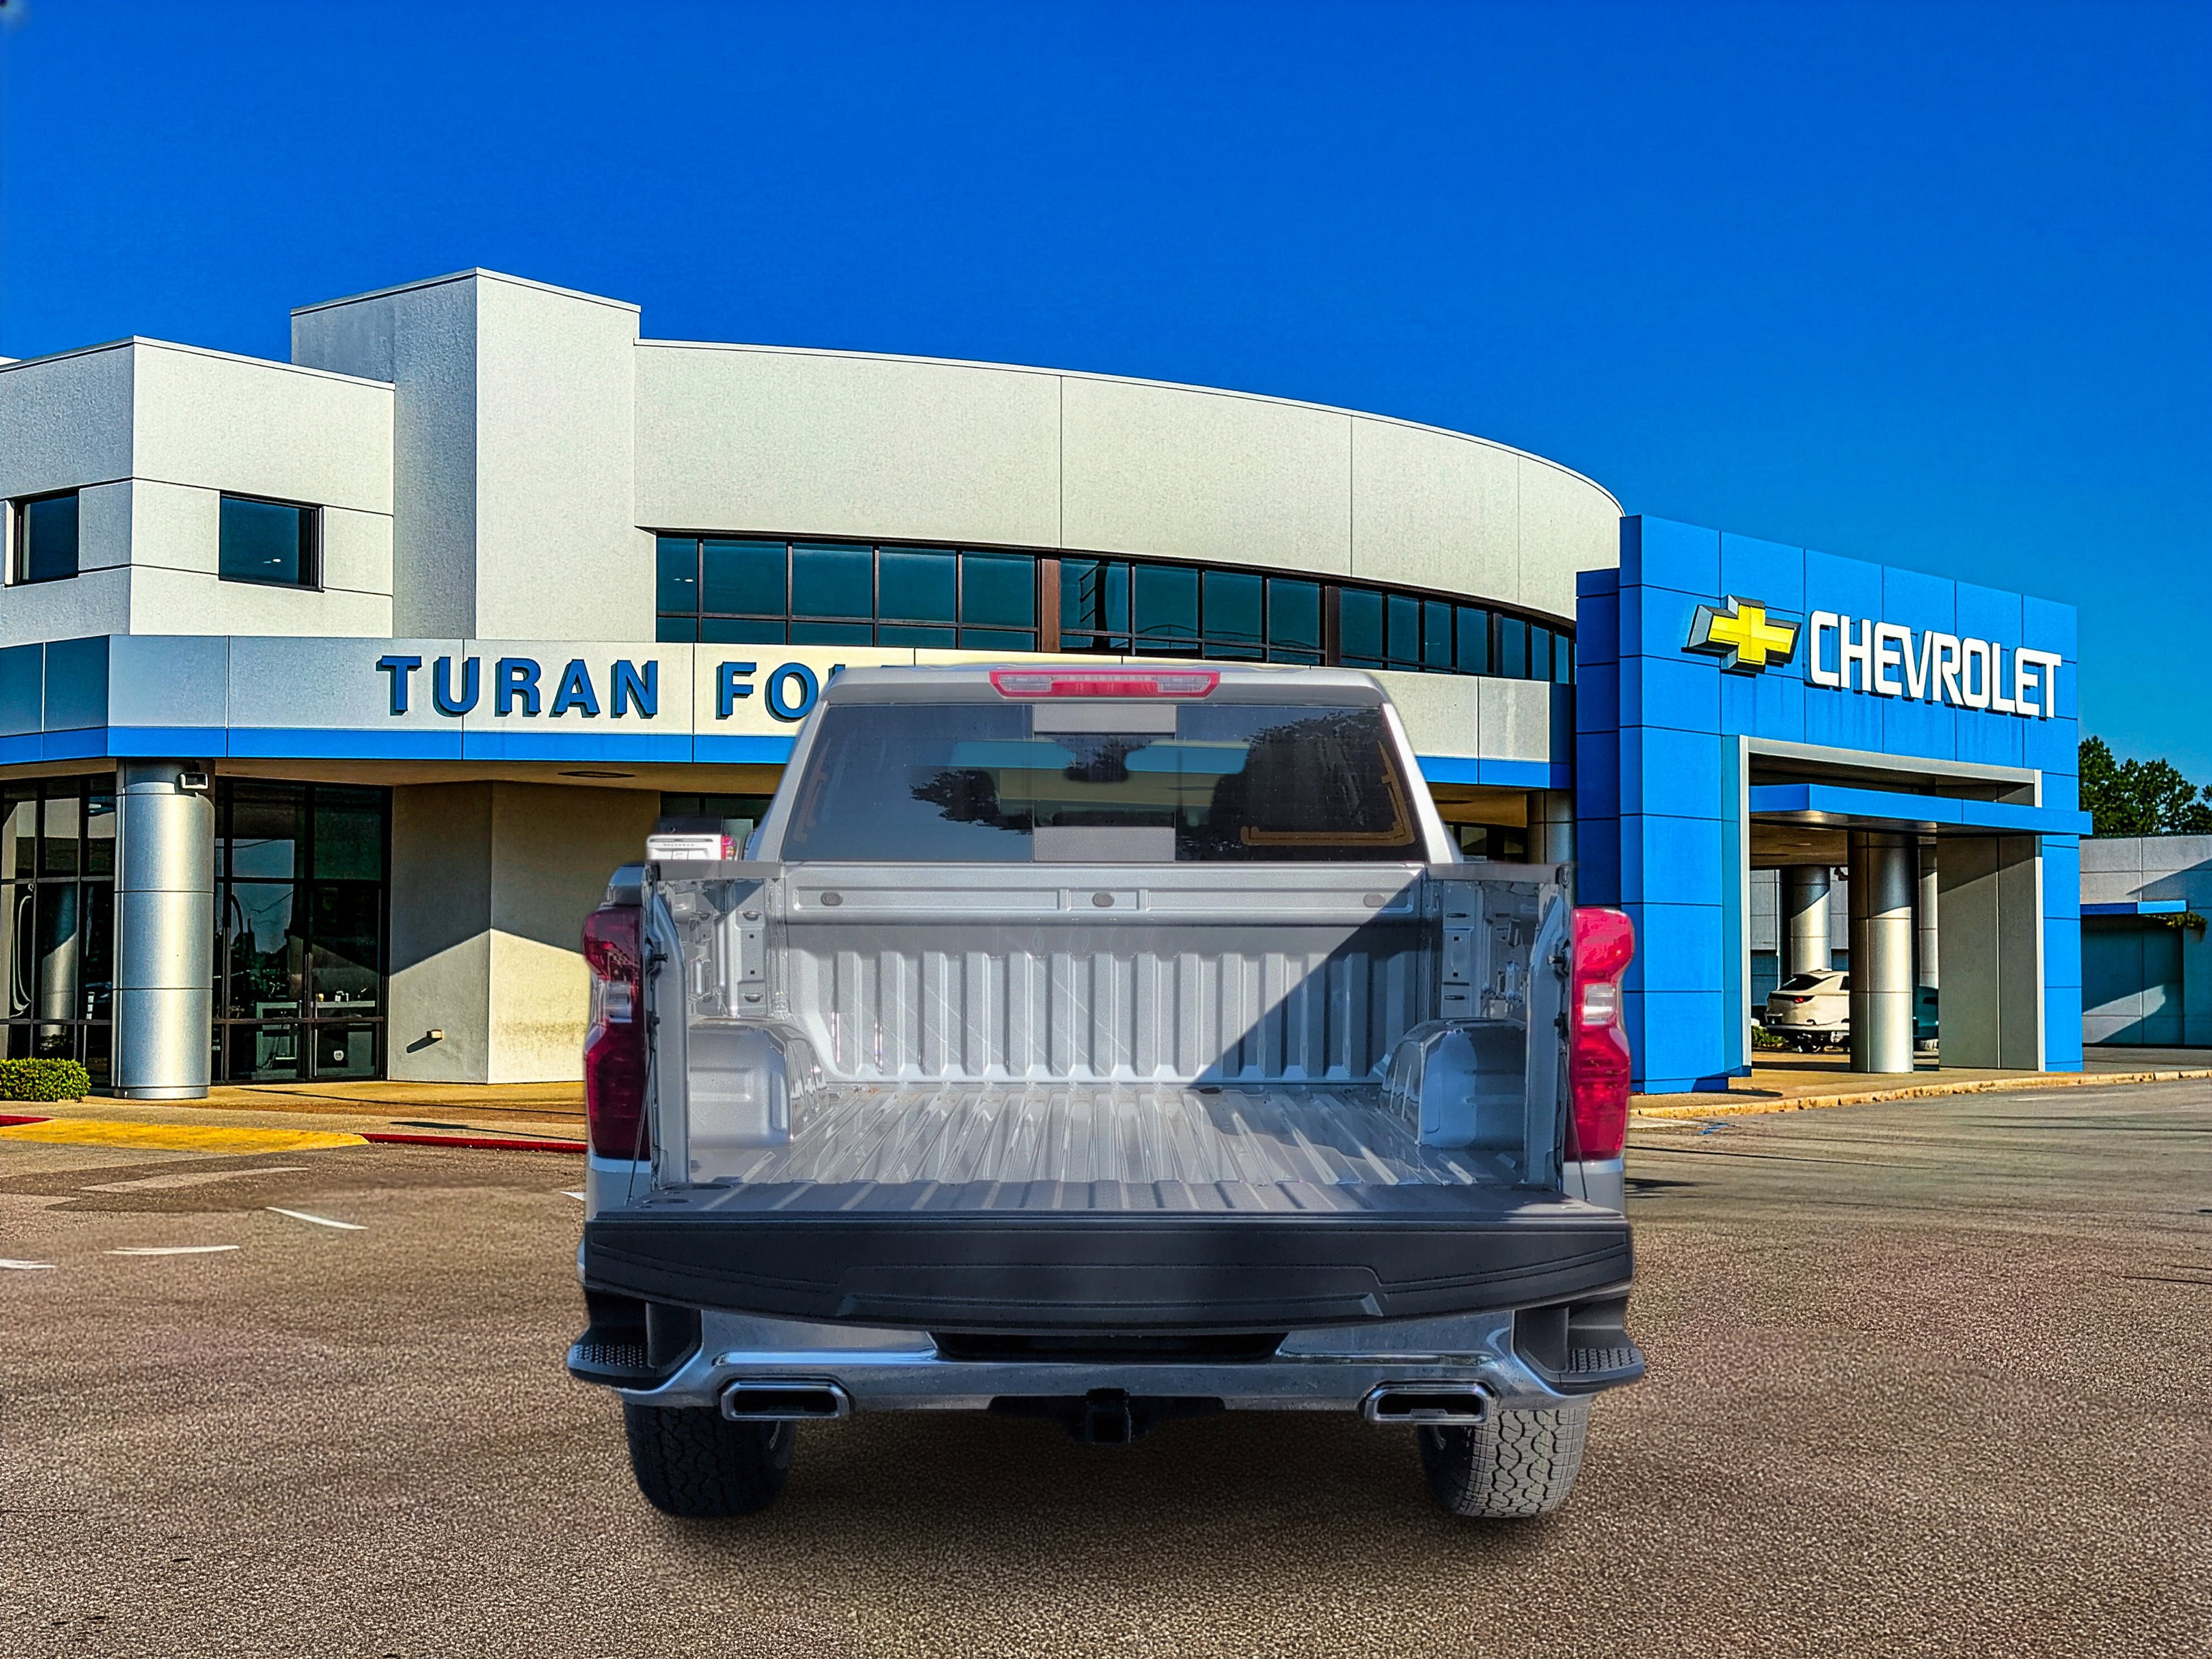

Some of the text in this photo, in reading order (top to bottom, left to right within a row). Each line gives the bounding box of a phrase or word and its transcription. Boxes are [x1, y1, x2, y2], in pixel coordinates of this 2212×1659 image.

[376, 655, 846, 723] TURAN FO
[1810, 610, 2062, 719] CHEVROLET
